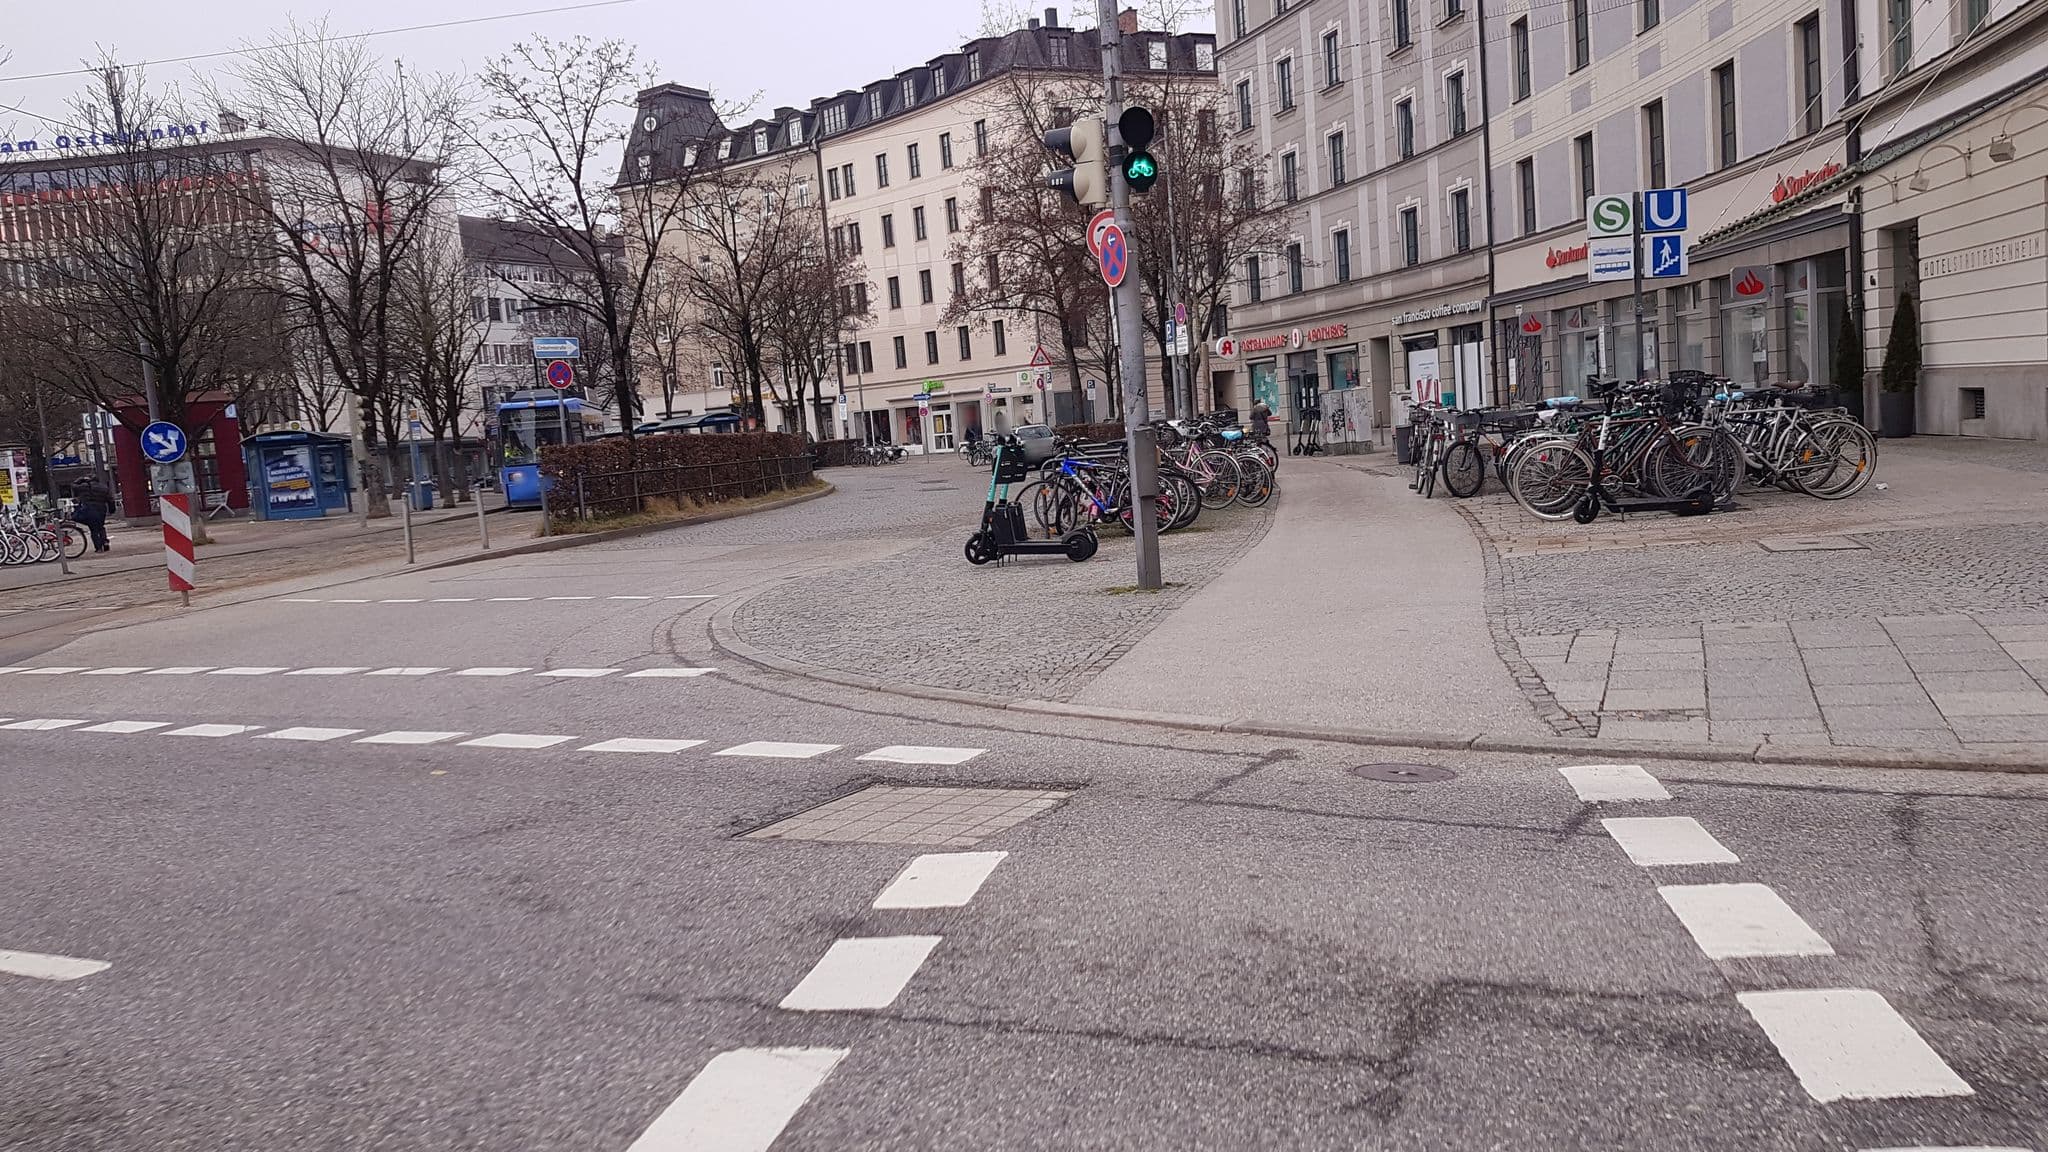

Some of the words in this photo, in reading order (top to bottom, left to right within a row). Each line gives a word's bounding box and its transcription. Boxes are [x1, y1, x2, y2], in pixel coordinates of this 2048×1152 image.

[0, 139, 38, 153] am
[1599, 199, 1625, 232] S
[1649, 190, 1682, 228] U
[1556, 242, 1589, 266] Santand
[1391, 314, 1403, 326] san
[1403, 309, 1431, 324] francisco
[1431, 303, 1452, 318] coffee
[1452, 299, 1483, 314] company
[1241, 334, 1287, 352] OSTBAHNHOF
[1307, 323, 1347, 342] APOTHEKE
